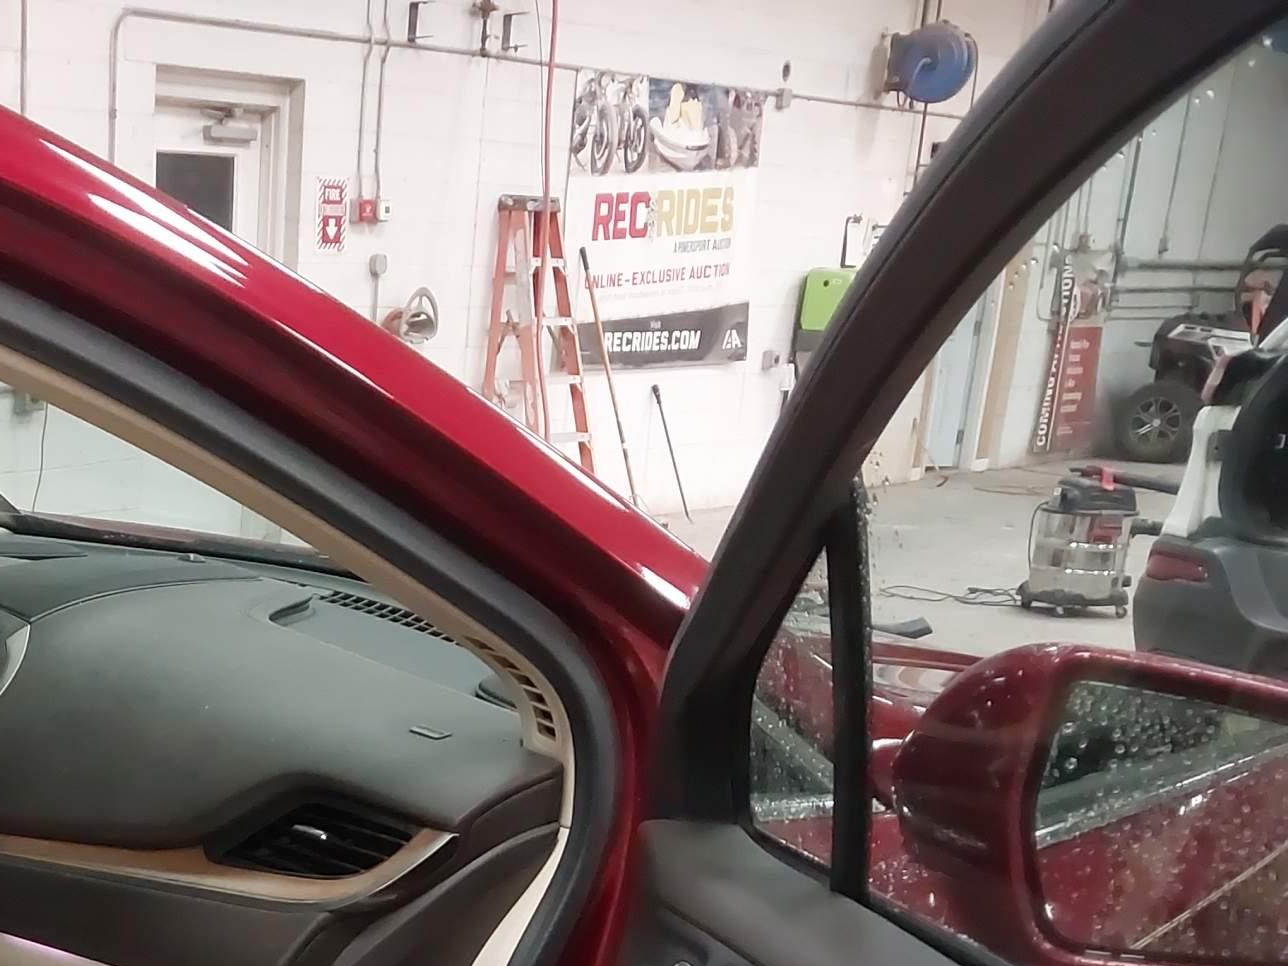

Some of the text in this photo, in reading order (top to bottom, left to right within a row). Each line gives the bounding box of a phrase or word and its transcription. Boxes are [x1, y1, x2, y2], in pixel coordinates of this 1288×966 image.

[325, 188, 341, 201] FIRE
[689, 262, 730, 280] AUCTION
[604, 330, 701, 353] RECRIDES.COM
